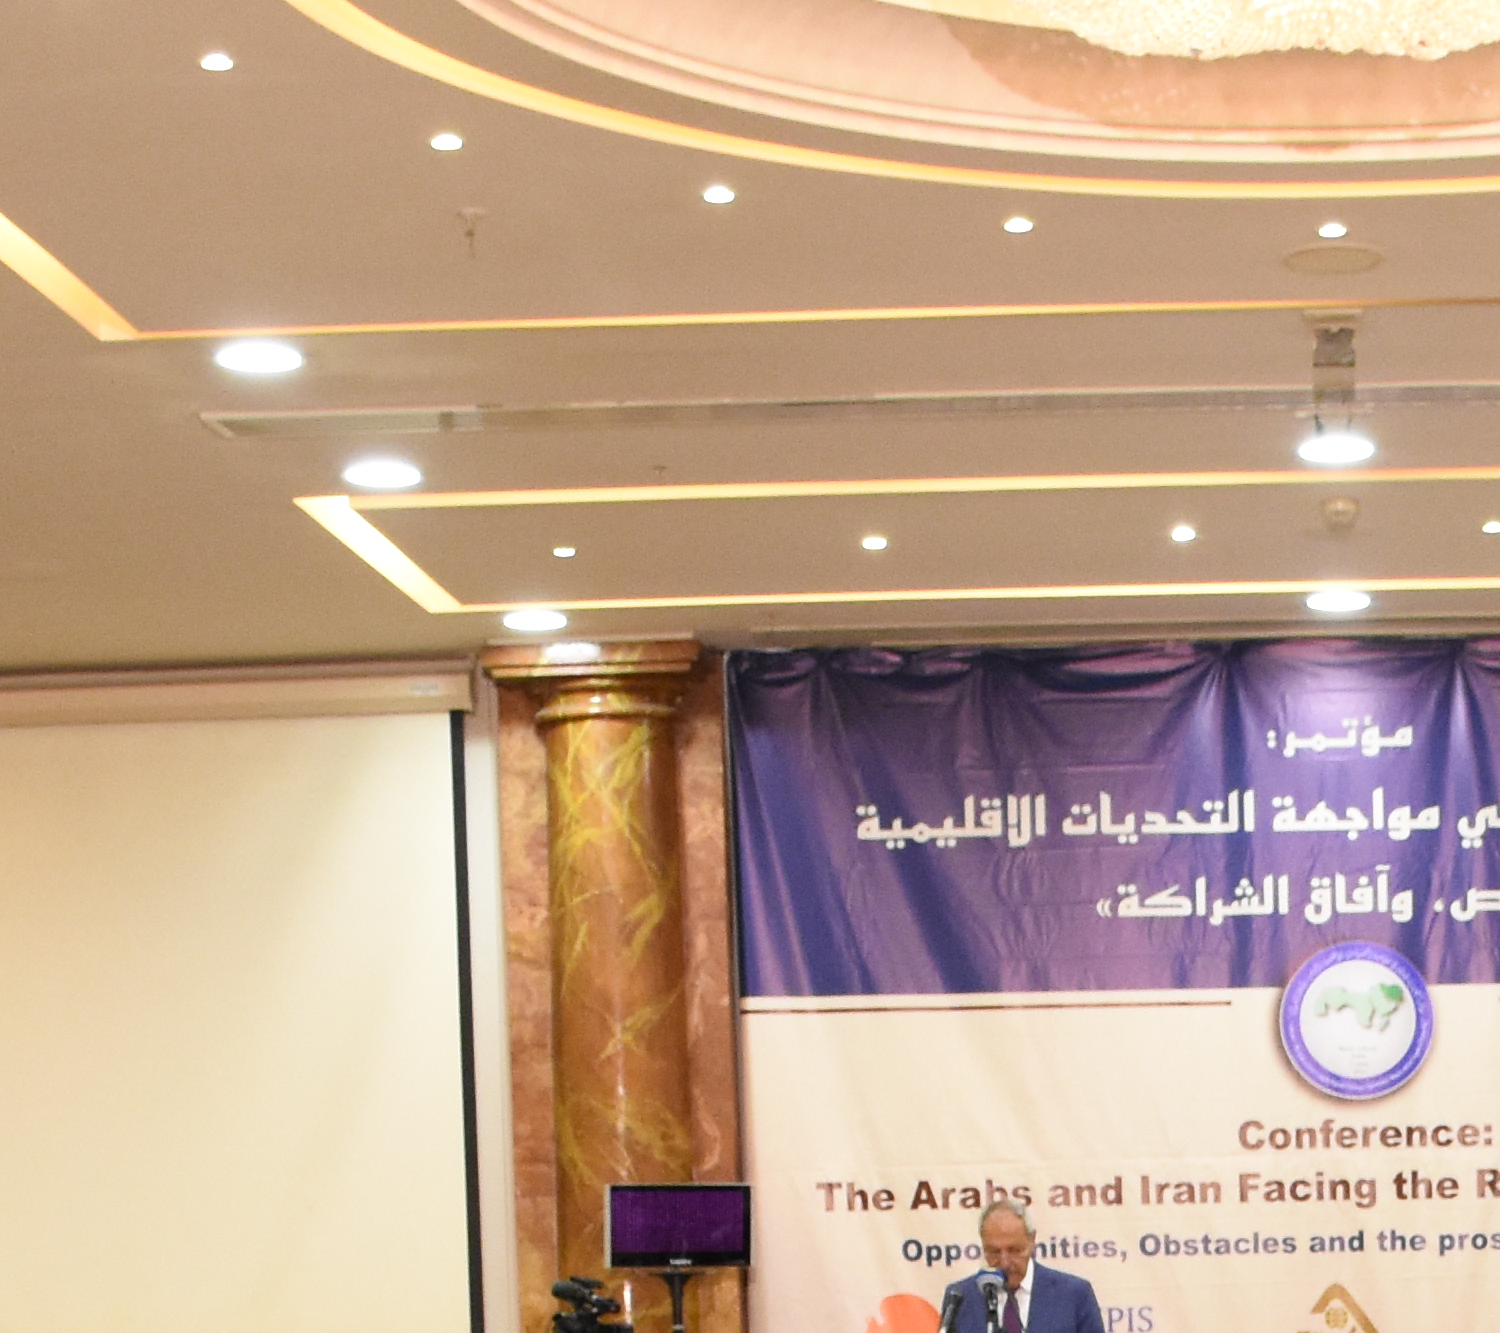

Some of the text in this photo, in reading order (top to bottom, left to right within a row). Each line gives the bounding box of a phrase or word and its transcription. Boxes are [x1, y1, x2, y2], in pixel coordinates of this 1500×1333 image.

[1267, 716, 1414, 757] مؤتمر:
[1062, 789, 1256, 845] التحديات
[1272, 786, 1441, 841] مواجهة
[1304, 864, 1414, 925] وآفاق
[1237, 1119, 1495, 1151] Conference:
[816, 1180, 896, 1212] The
[909, 1179, 1032, 1210] Arabs
[1047, 1175, 1124, 1208] and
[1140, 1174, 1222, 1206] Iran
[1238, 1170, 1377, 1212] Facing
[1392, 1169, 1460, 1200] the
[902, 1233, 1128, 1268] Opponities,
[1139, 1230, 1302, 1257] Obstacles
[1309, 1230, 1365, 1254] and
[1376, 1227, 1427, 1252] the
[1105, 1306, 1155, 1333] PIS
